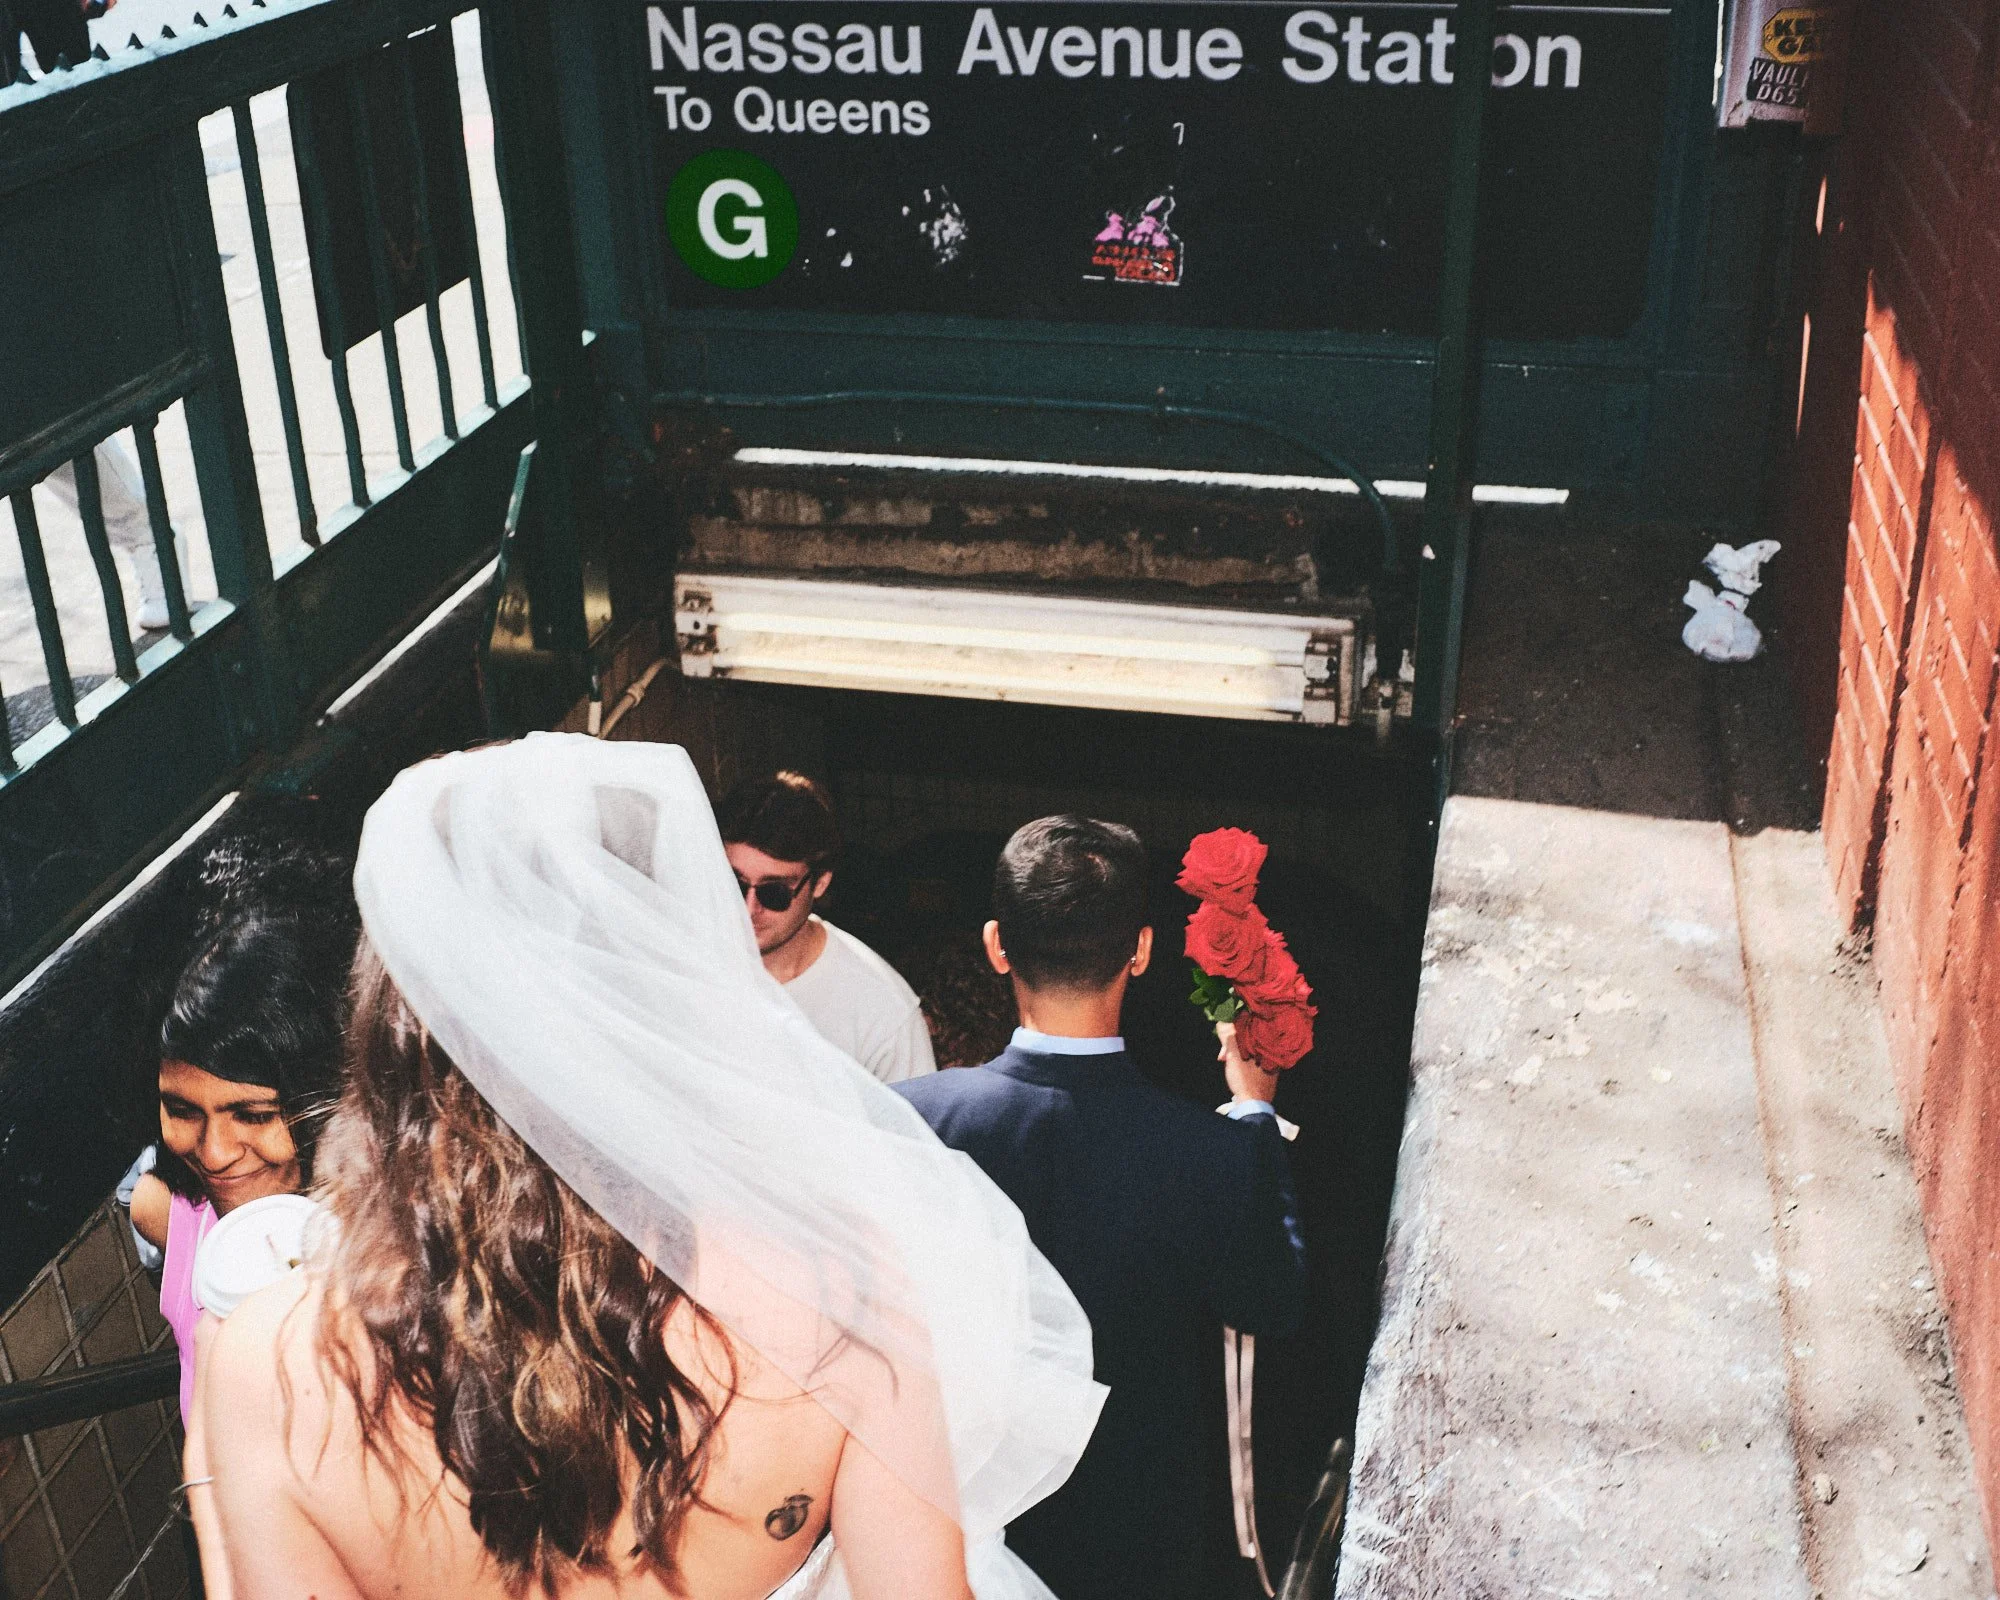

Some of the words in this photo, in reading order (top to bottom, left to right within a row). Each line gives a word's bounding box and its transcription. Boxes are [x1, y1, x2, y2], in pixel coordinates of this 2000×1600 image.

[647, 7, 921, 74] Nassau
[958, 8, 1243, 80] Avenue
[1282, 10, 1581, 87] Staton
[654, 87, 711, 131] To
[734, 87, 930, 135] Queens
[698, 179, 768, 259] G
